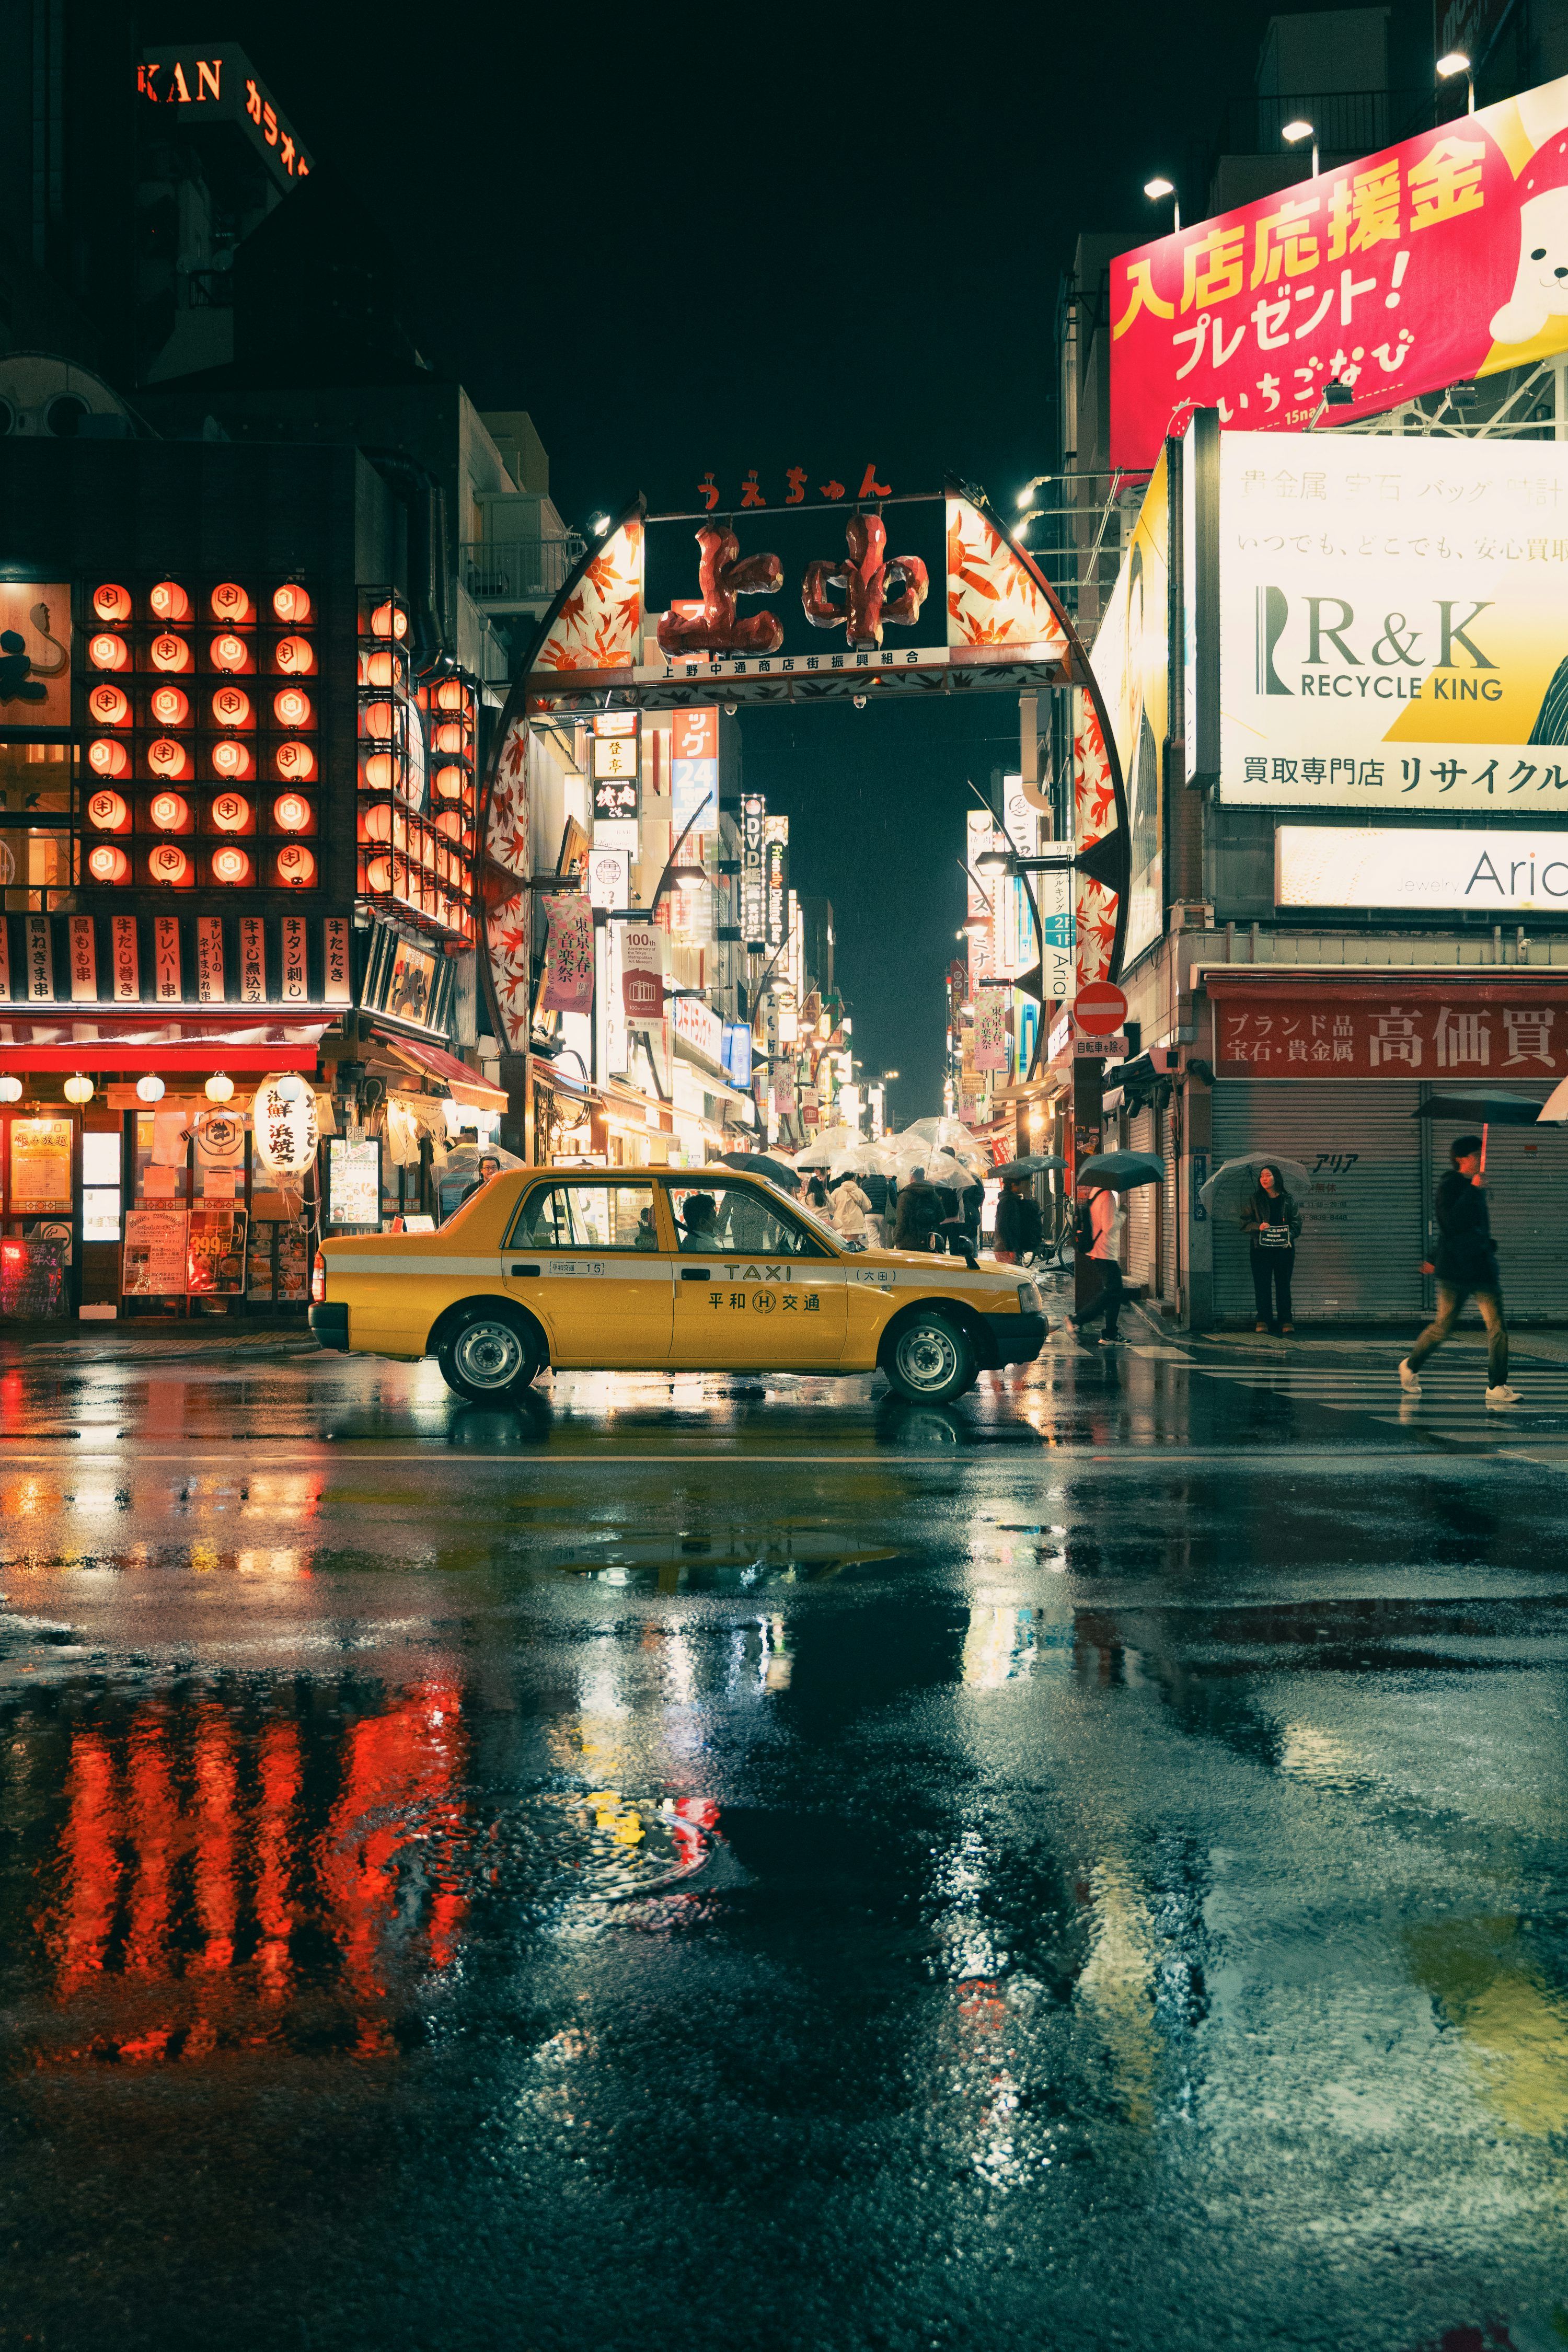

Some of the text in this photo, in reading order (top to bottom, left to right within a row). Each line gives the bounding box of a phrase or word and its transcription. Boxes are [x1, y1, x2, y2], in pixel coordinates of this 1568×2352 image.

[1113, 136, 1485, 341] 入店応援金
[1217, 328, 1415, 423] いちごなび
[1240, 469, 1327, 501] 貴金属
[1417, 479, 1494, 504] バッグ
[102, 592, 113, 603] 牛
[222, 590, 234, 601] 牛
[161, 643, 173, 655] 牛
[280, 648, 289, 659] 牛
[662, 651, 919, 679] 上野中通商店街振興組合
[1301, 674, 1503, 701] RECYCLE KING
[100, 695, 113, 707] 牛
[224, 697, 236, 709] 牛
[158, 747, 169, 758] 牛
[282, 750, 292, 761] 牛
[677, 761, 713, 787] 24
[1243, 756, 1385, 787] 買取専門店
[97, 801, 109, 812] 牛
[596, 786, 636, 807] 焼肉
[222, 802, 234, 814] 牛
[163, 853, 175, 864] 牛
[285, 852, 295, 863] 牛
[1397, 878, 1460, 895] Jewelry
[973, 897, 990, 969] スミナ
[1055, 917, 1074, 928] 2F
[74, 918, 91, 981] 鳥もも串
[210, 919, 222, 972] 牛レバーの
[575, 917, 591, 978] 東京・春・
[626, 933, 656, 947] 100th
[1056, 935, 1073, 946] 1F
[117, 918, 133, 996] 牛だし巻き
[159, 919, 176, 997] 牛レバー串
[244, 920, 261, 1002] 牛すじ煮込み
[286, 919, 302, 997] 牛タン刺し
[329, 920, 344, 982] 牛たたき
[557, 932, 574, 983] 音楽祭
[200, 937, 211, 1001] ネギまみれ串
[1053, 954, 1069, 995] Aria
[981, 1017, 991, 1050] 音楽祭
[1227, 1013, 1354, 1037] ブランド品
[1077, 1040, 1124, 1054] 自転車を除く
[1368, 1007, 1568, 1068] 高価買
[1227, 1040, 1354, 1062] 宝石・貴金属
[15, 1134, 68, 1147] 飲み放題
[347, 1127, 365, 1140] 2階
[1313, 1154, 1358, 1173] アリア
[724, 1264, 791, 1282] TAXI
[708, 1293, 745, 1310] 平和
[782, 1294, 820, 1311] 交通
